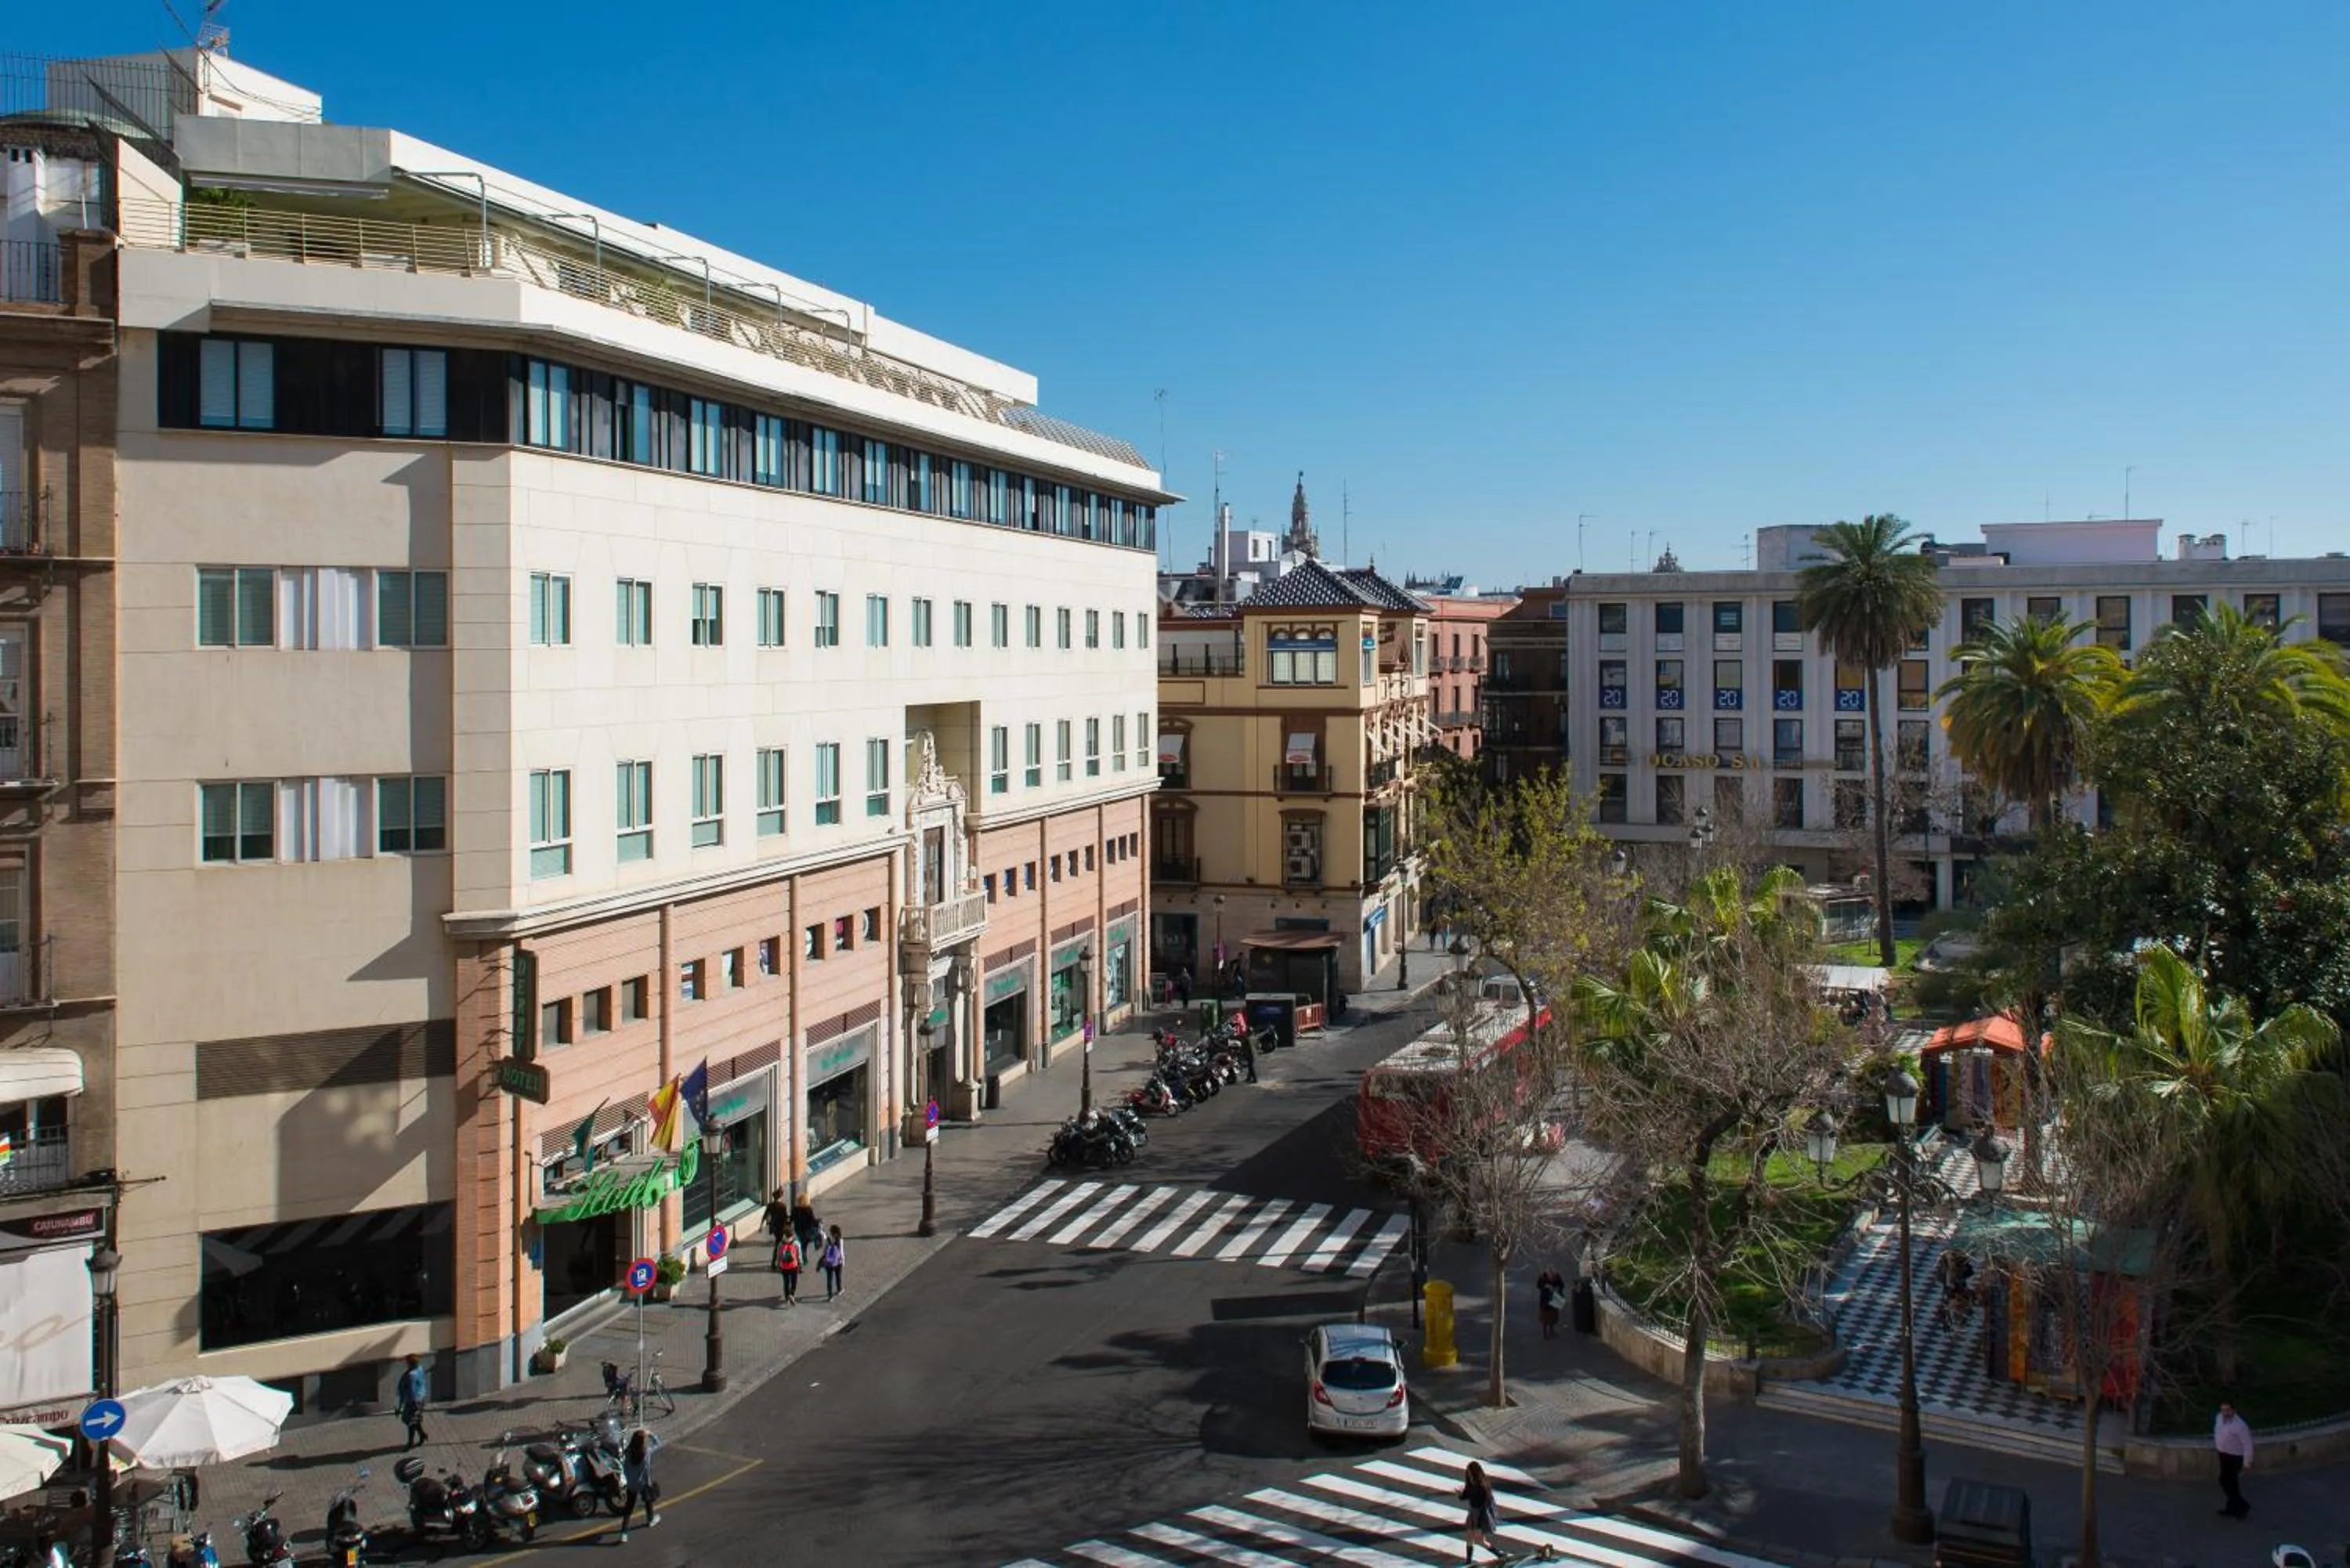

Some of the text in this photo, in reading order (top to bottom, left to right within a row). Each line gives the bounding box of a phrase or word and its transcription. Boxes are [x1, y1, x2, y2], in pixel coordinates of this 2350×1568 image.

[1603, 689, 1621, 705] 20
[1660, 689, 1678, 705] 20
[1719, 690, 1737, 706] 20
[1777, 690, 1798, 706] 20
[1840, 690, 1860, 706] 20
[1647, 753, 1720, 768] OCASO
[515, 958, 527, 1051] DERBY
[502, 1066, 540, 1092] HOTEL
